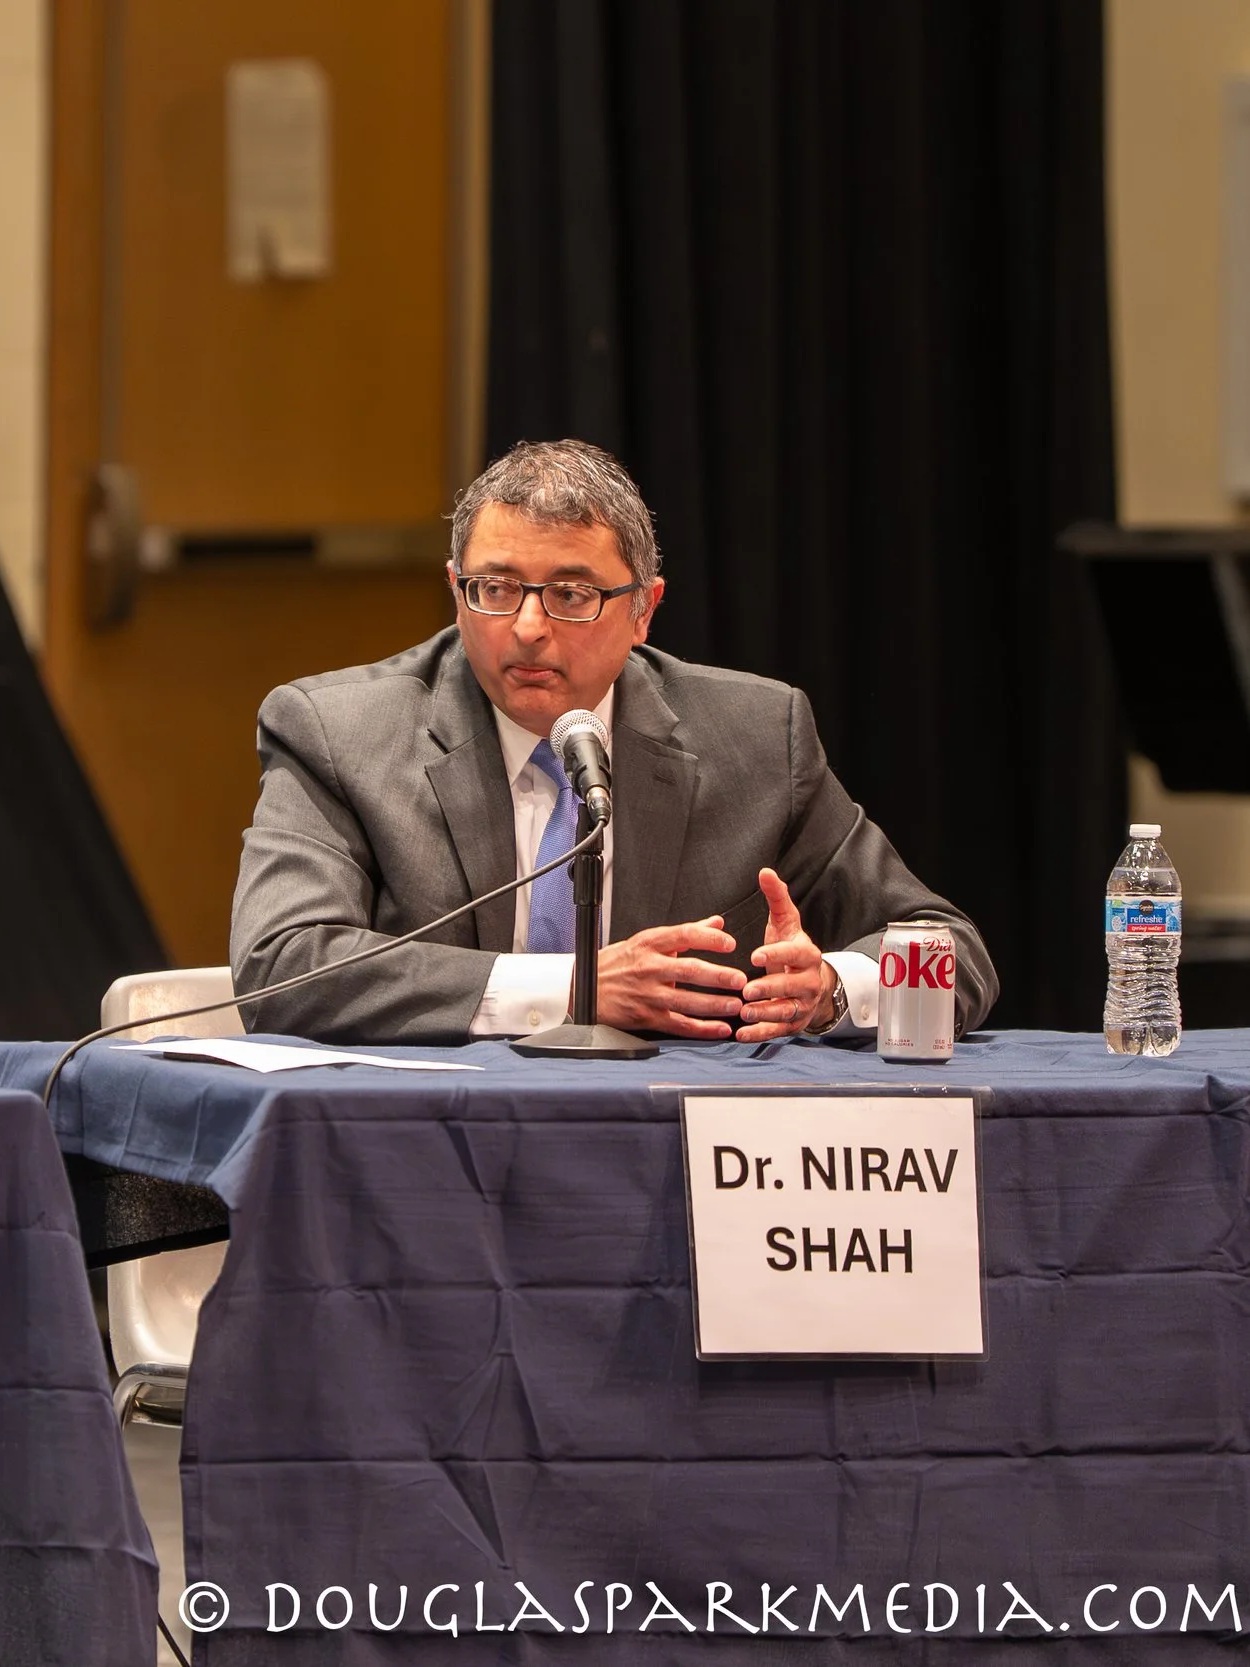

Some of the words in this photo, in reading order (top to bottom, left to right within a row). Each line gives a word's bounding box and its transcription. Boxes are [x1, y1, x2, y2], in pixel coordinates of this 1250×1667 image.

[879, 940, 955, 990] oke
[713, 1145, 784, 1190] Dr.
[801, 1146, 959, 1193] NIRAV
[765, 1226, 914, 1274] SHAH
